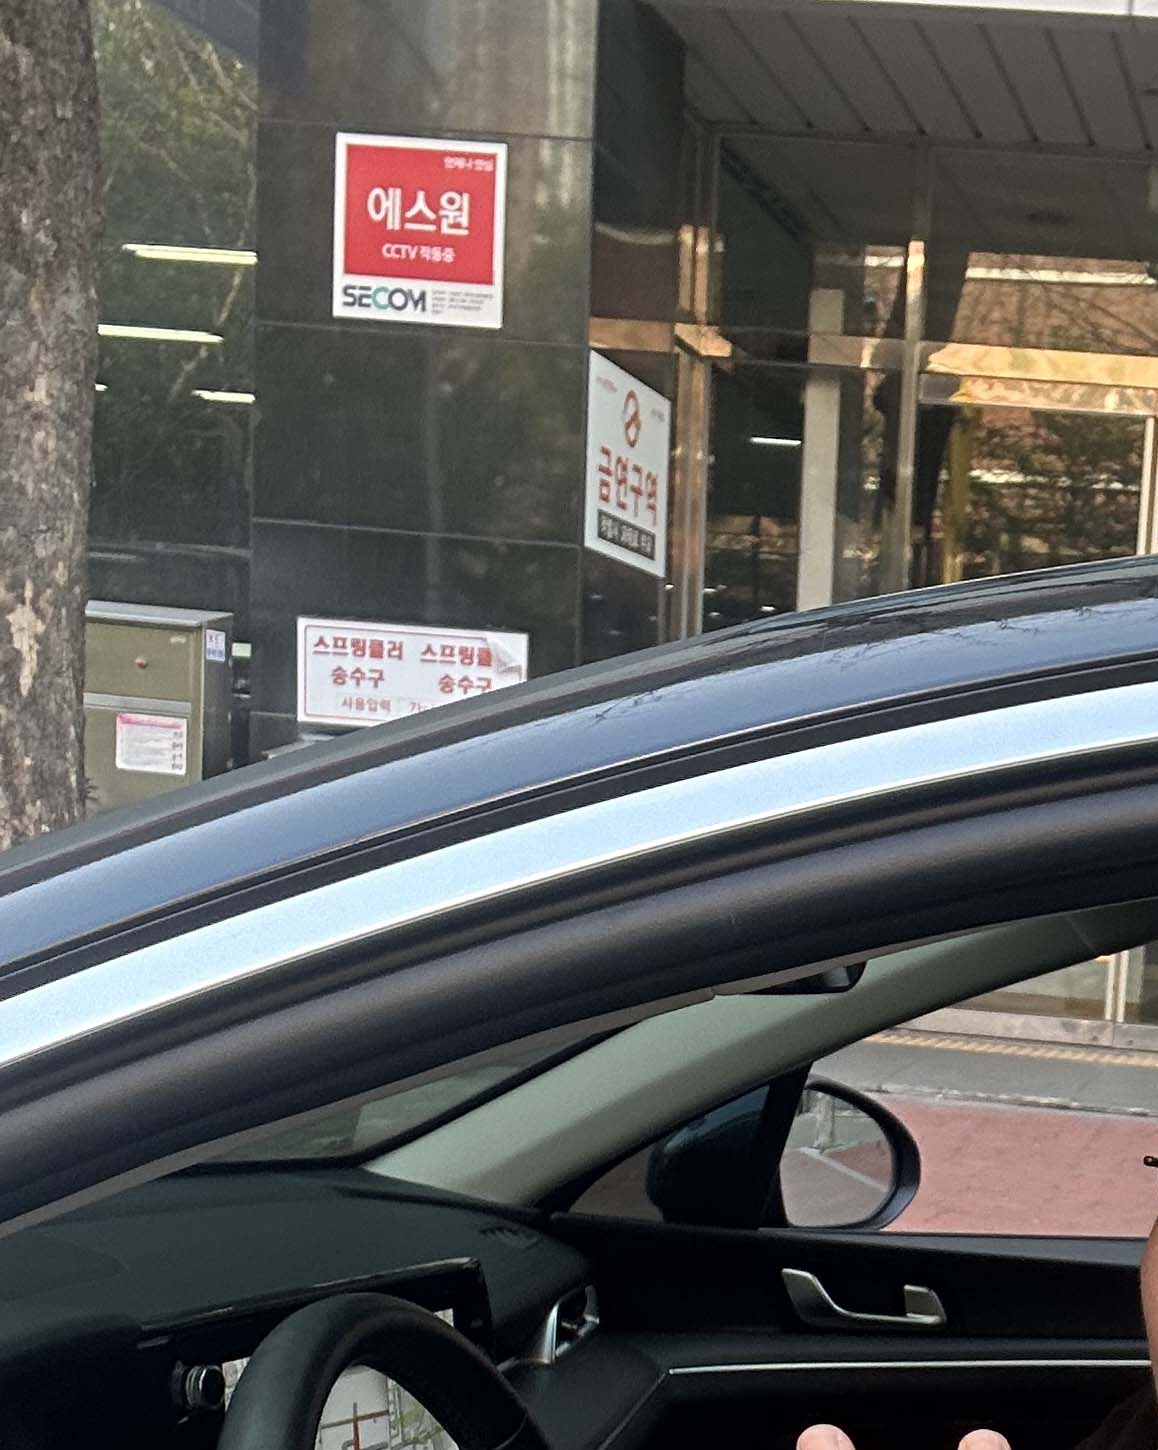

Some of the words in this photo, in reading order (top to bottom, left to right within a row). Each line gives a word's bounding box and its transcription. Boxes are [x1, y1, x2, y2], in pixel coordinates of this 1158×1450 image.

[367, 187, 470, 236] 에스원
[382, 243, 418, 260] CCTV
[342, 284, 427, 313] SECOM
[598, 446, 658, 526] 금연구역
[420, 643, 493, 667] 스프링클
[331, 665, 385, 688] 송수구
[438, 673, 493, 694] 송수구
